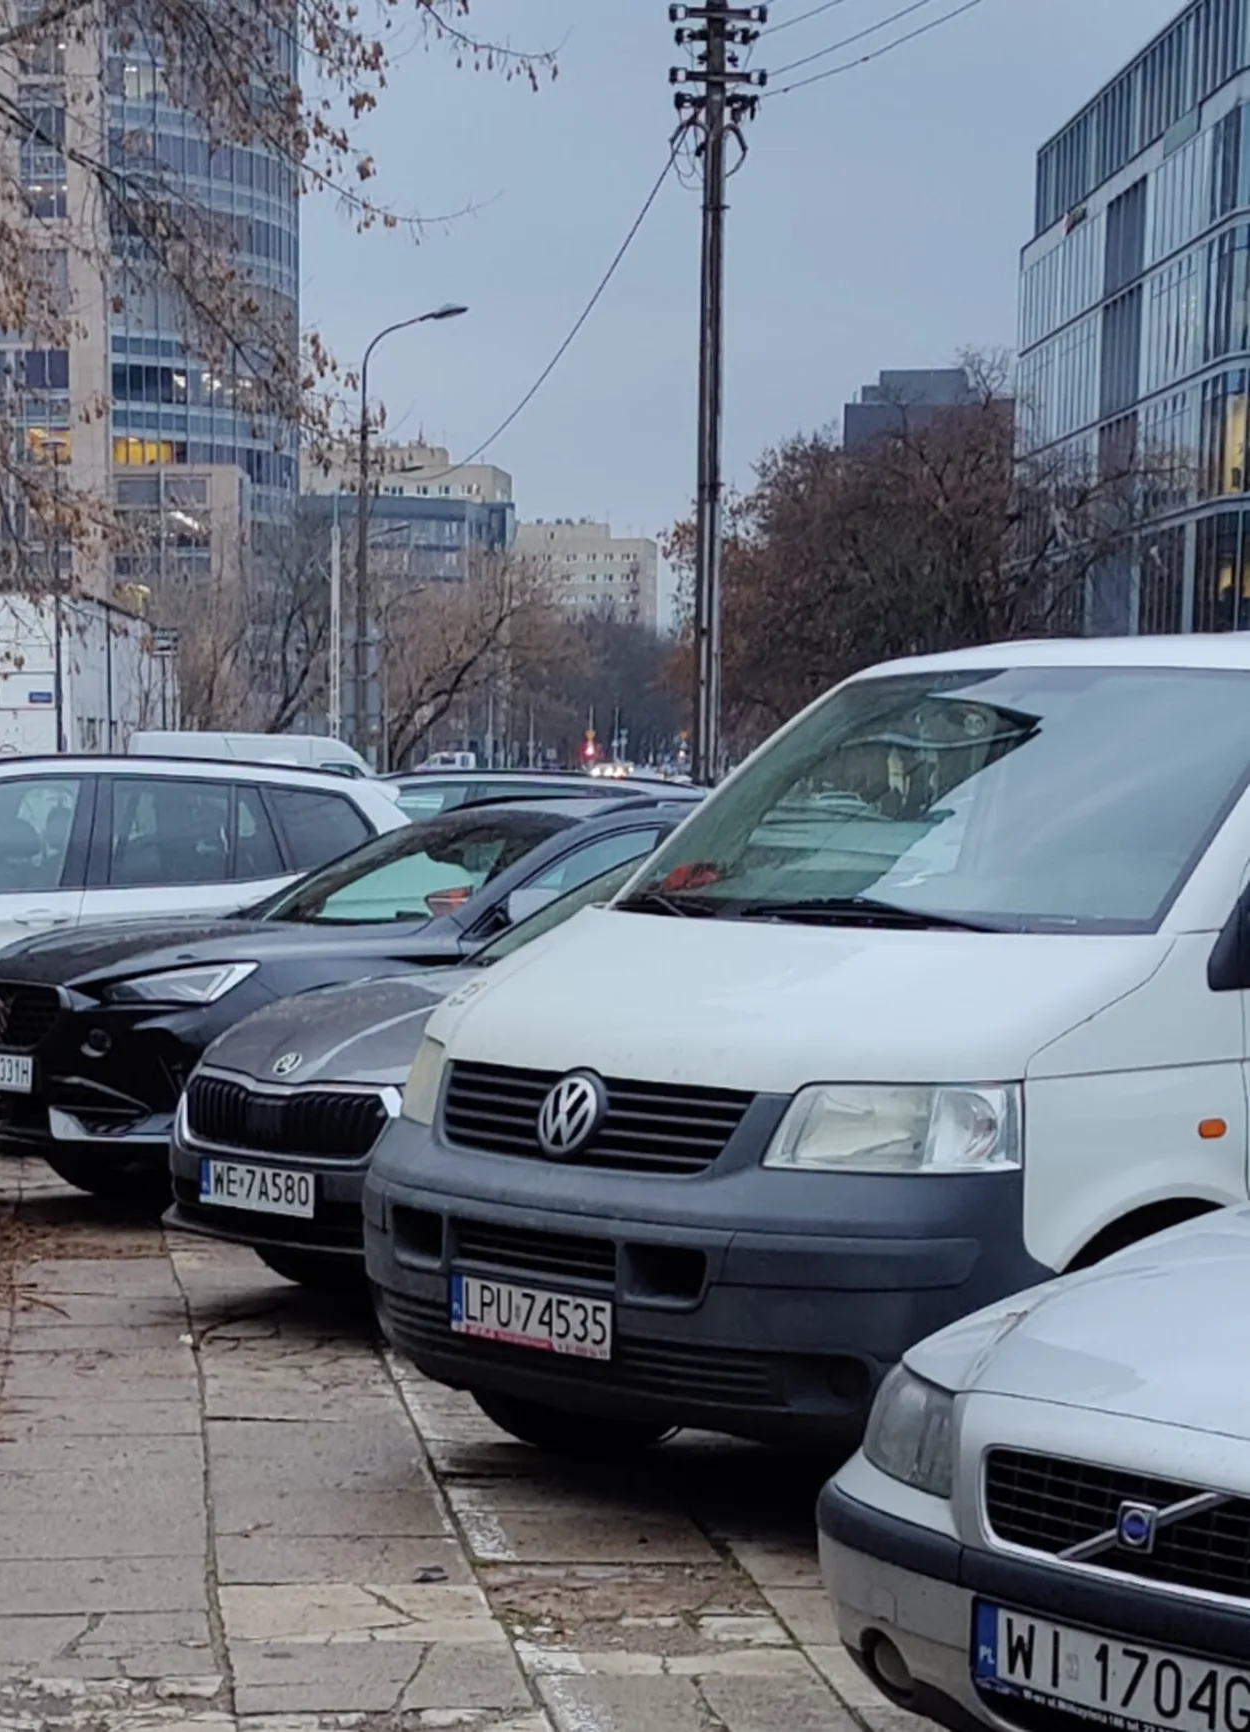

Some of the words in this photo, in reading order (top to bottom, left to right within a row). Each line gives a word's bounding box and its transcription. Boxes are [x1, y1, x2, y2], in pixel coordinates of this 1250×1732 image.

[213, 1163, 238, 1197] WE
[245, 1168, 309, 1206] 7A580
[465, 1281, 513, 1328] LPU
[521, 1292, 607, 1346] 74535
[979, 1644, 996, 1664] PL
[1006, 1617, 1060, 1689] WI
[1094, 1643, 1250, 1732] 1704G
